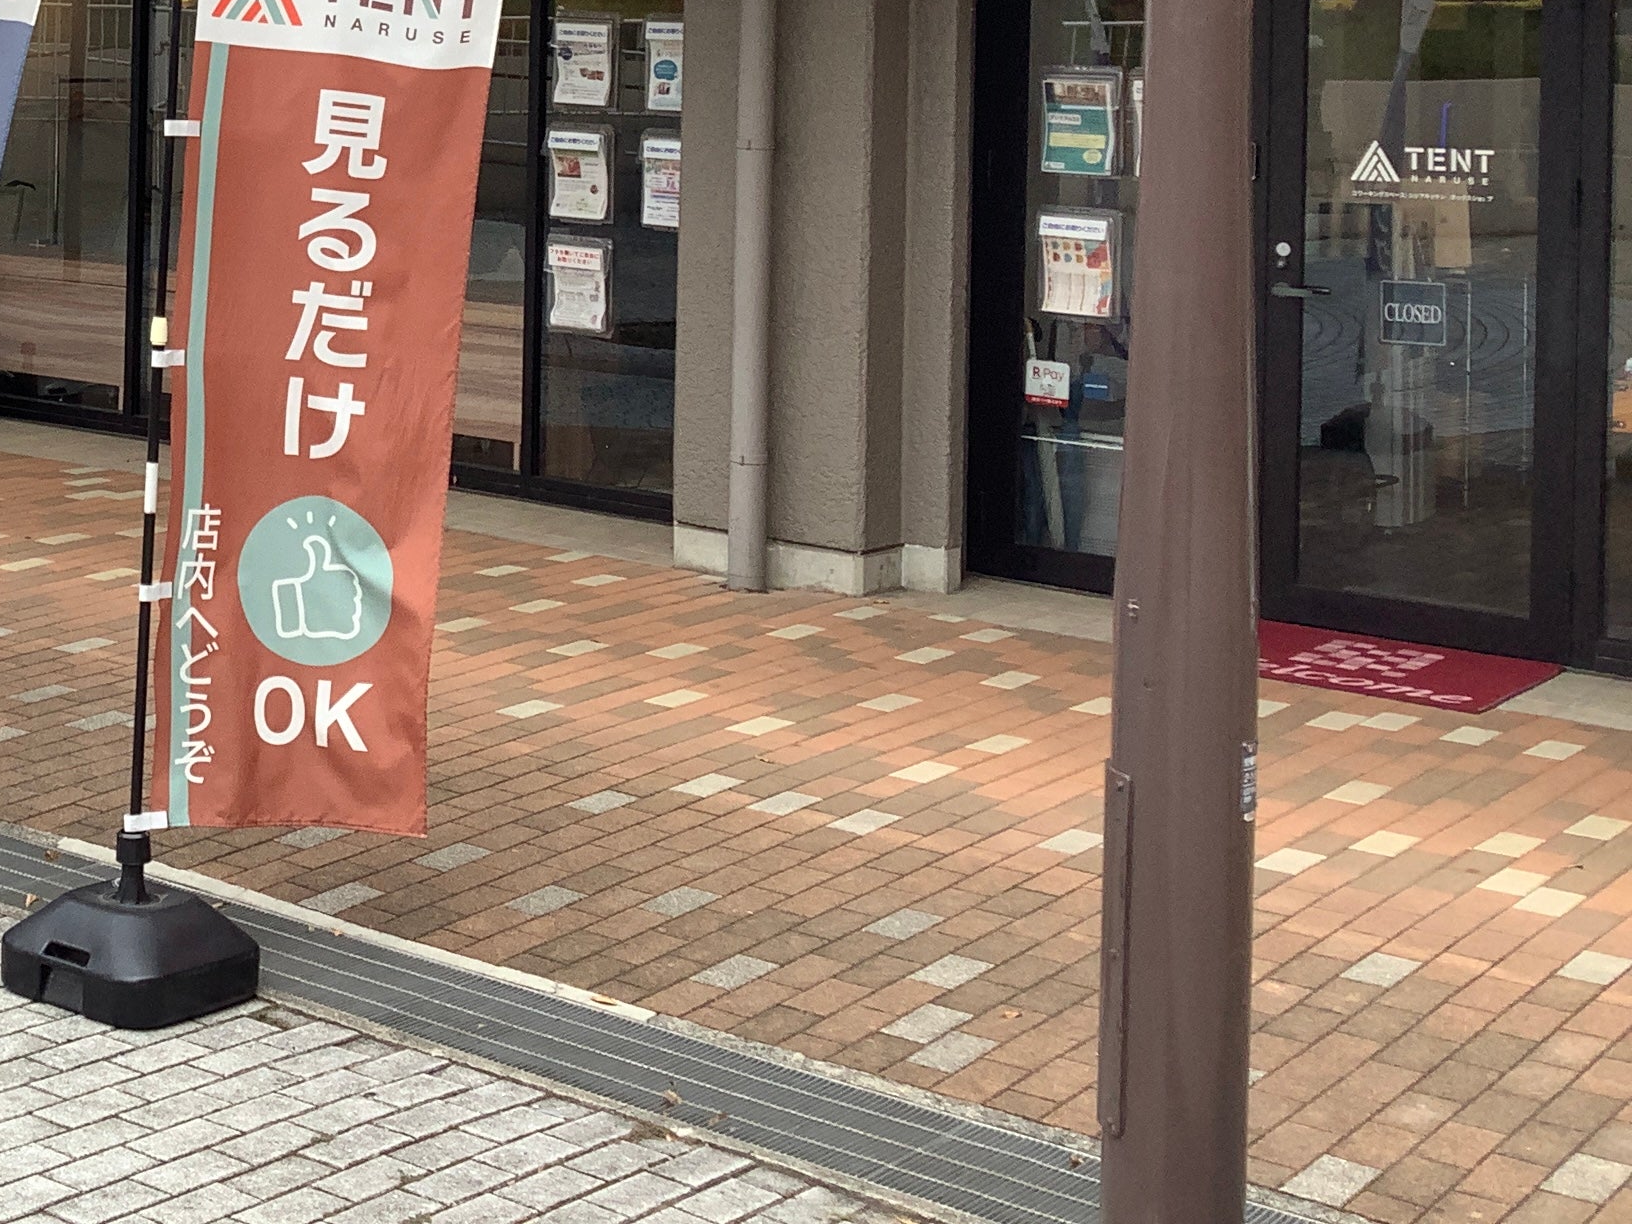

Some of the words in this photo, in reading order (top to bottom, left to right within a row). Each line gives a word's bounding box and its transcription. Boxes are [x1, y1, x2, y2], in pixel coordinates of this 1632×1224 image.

[323, 13, 472, 45] NARUSE
[1404, 147, 1495, 174] TENT
[1411, 174, 1489, 186] NARUSE
[283, 88, 388, 460] 見るだけ
[1384, 302, 1442, 324] CLOSED
[1043, 368, 1065, 382] Pay
[174, 503, 222, 785] 店内へどうぞ
[253, 675, 374, 753] OK
